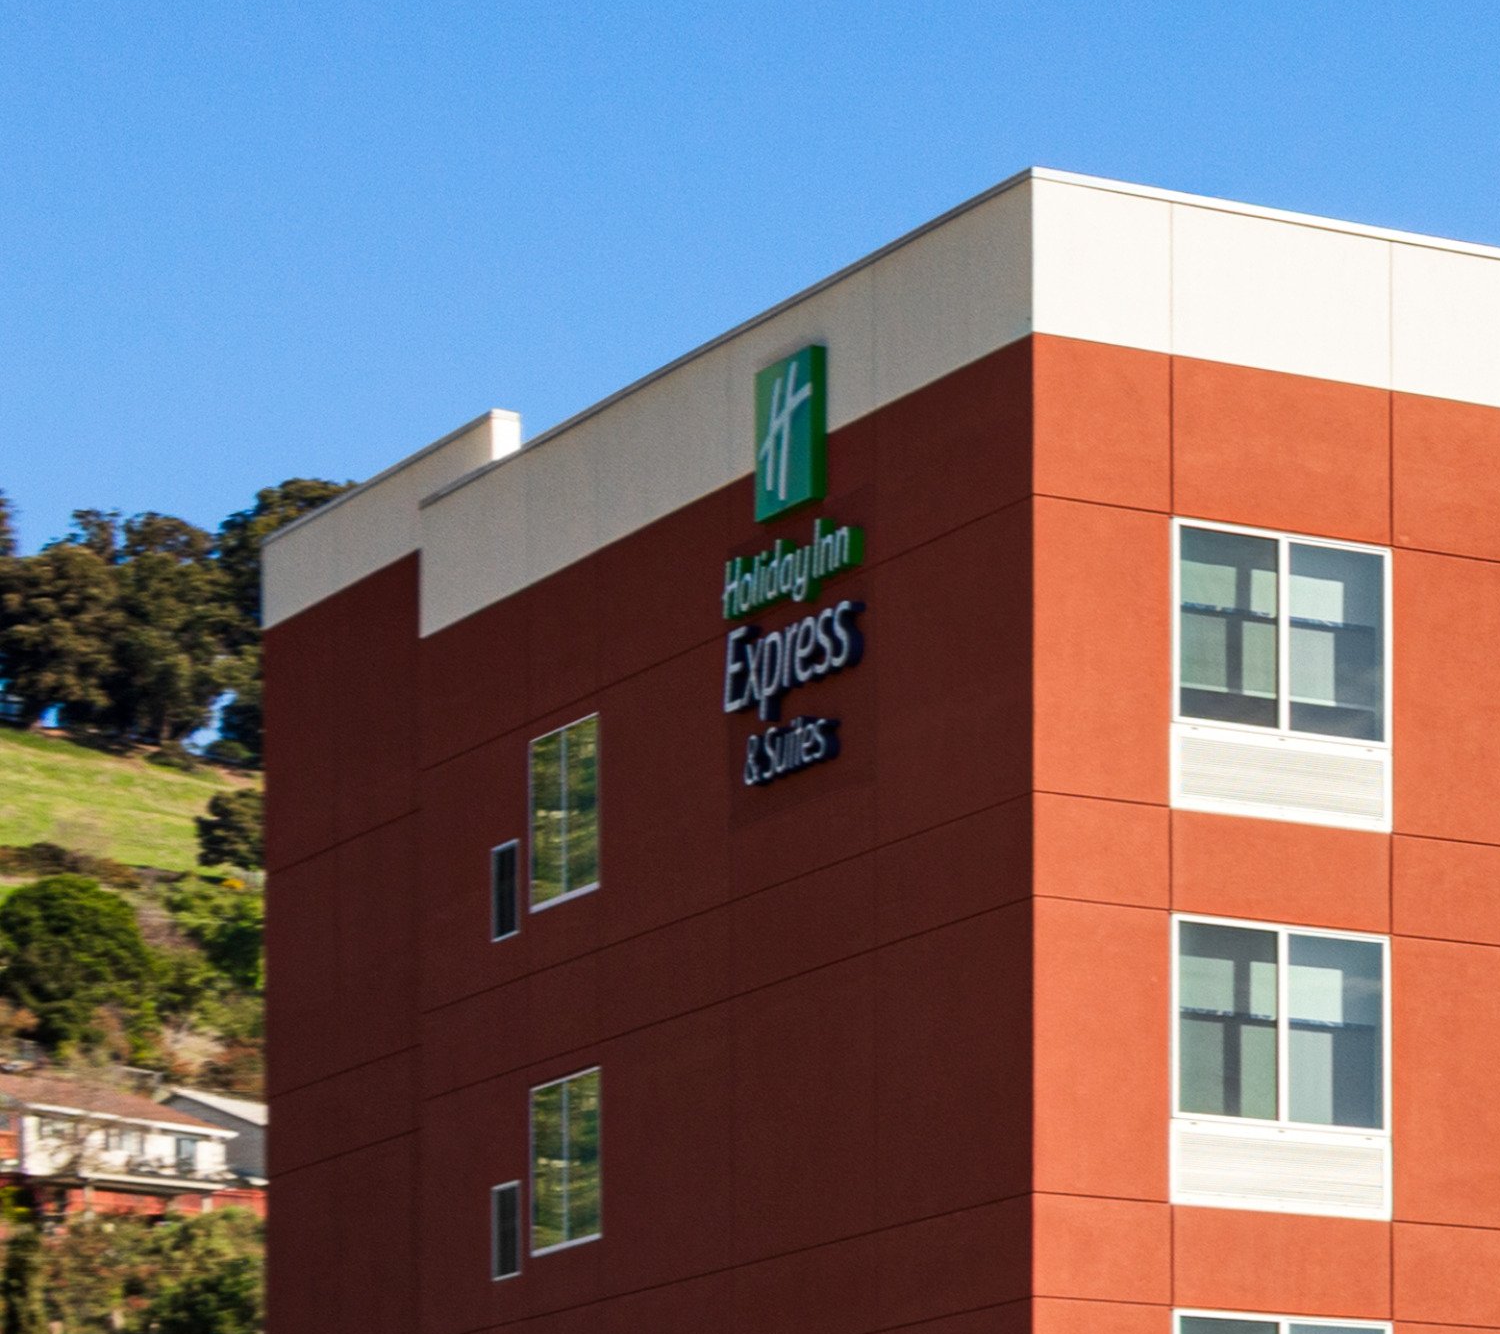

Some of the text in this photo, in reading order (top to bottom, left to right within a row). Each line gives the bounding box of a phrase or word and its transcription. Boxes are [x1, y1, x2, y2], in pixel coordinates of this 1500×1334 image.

[722, 518, 849, 619] Holiday Inn
[724, 601, 852, 720] Express
[744, 717, 827, 785] & Suites
